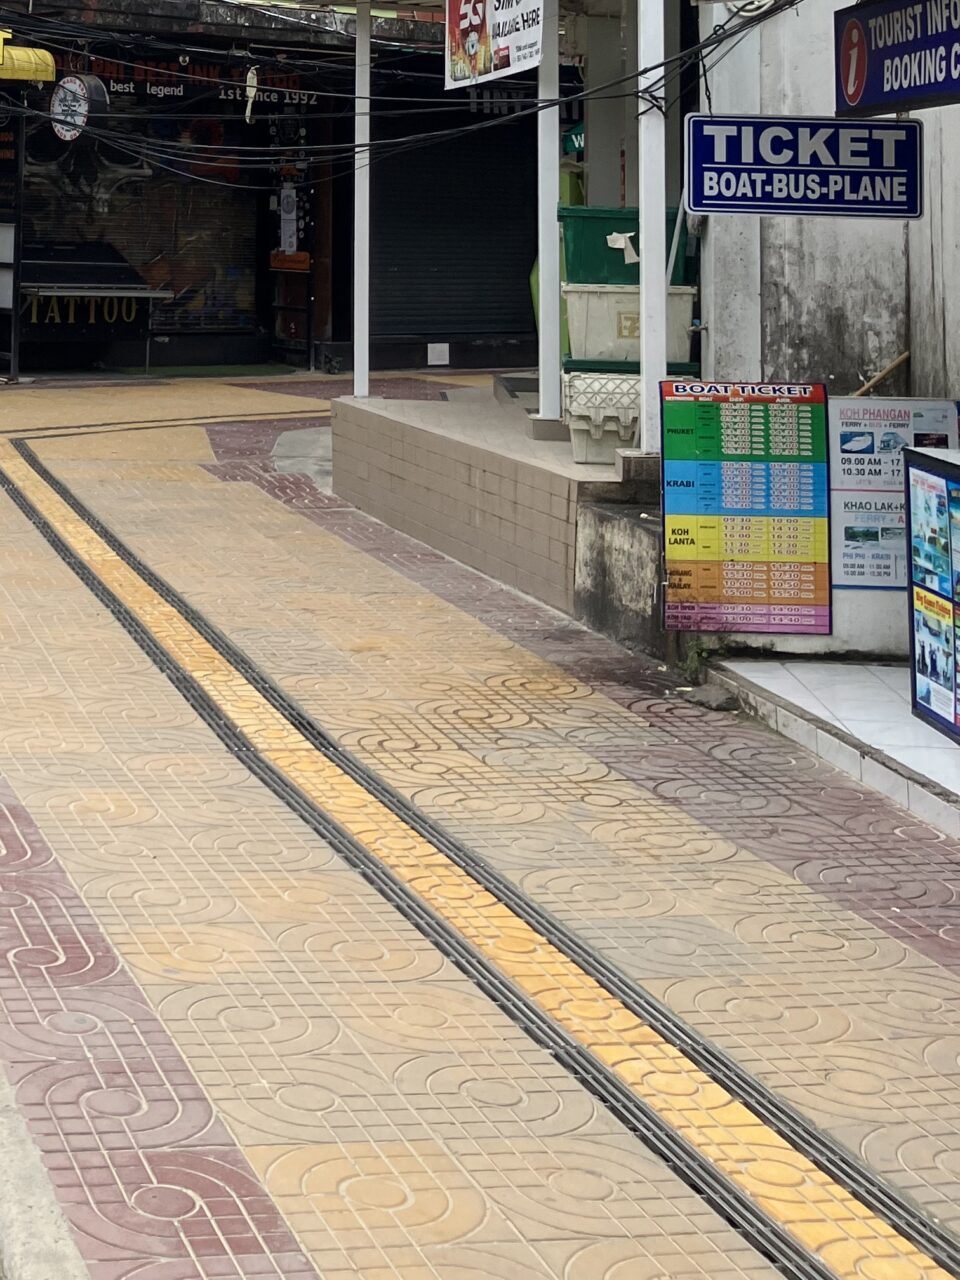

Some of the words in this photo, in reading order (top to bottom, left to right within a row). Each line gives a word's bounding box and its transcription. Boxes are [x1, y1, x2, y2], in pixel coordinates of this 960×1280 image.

[868, 4, 922, 51] TOURIST
[883, 46, 947, 92] BOOKING
[110, 79, 135, 93] best
[146, 82, 184, 98] legend
[283, 90, 318, 105] 1992
[703, 125, 907, 167] TICKET
[703, 171, 908, 201] BOAT-BUS-PLANE
[30, 296, 137, 324] TATTOO
[674, 384, 731, 395] BOAT
[740, 385, 812, 397] TICKET
[840, 407, 860, 419] KOH
[862, 409, 911, 421] PHANGAN
[841, 458, 865, 466] 09.00
[867, 458, 881, 466] AM
[842, 468, 865, 476] 10.30
[666, 480, 695, 488] KRABI
[843, 501, 872, 511] KHAO
[671, 528, 689, 536] KOH
